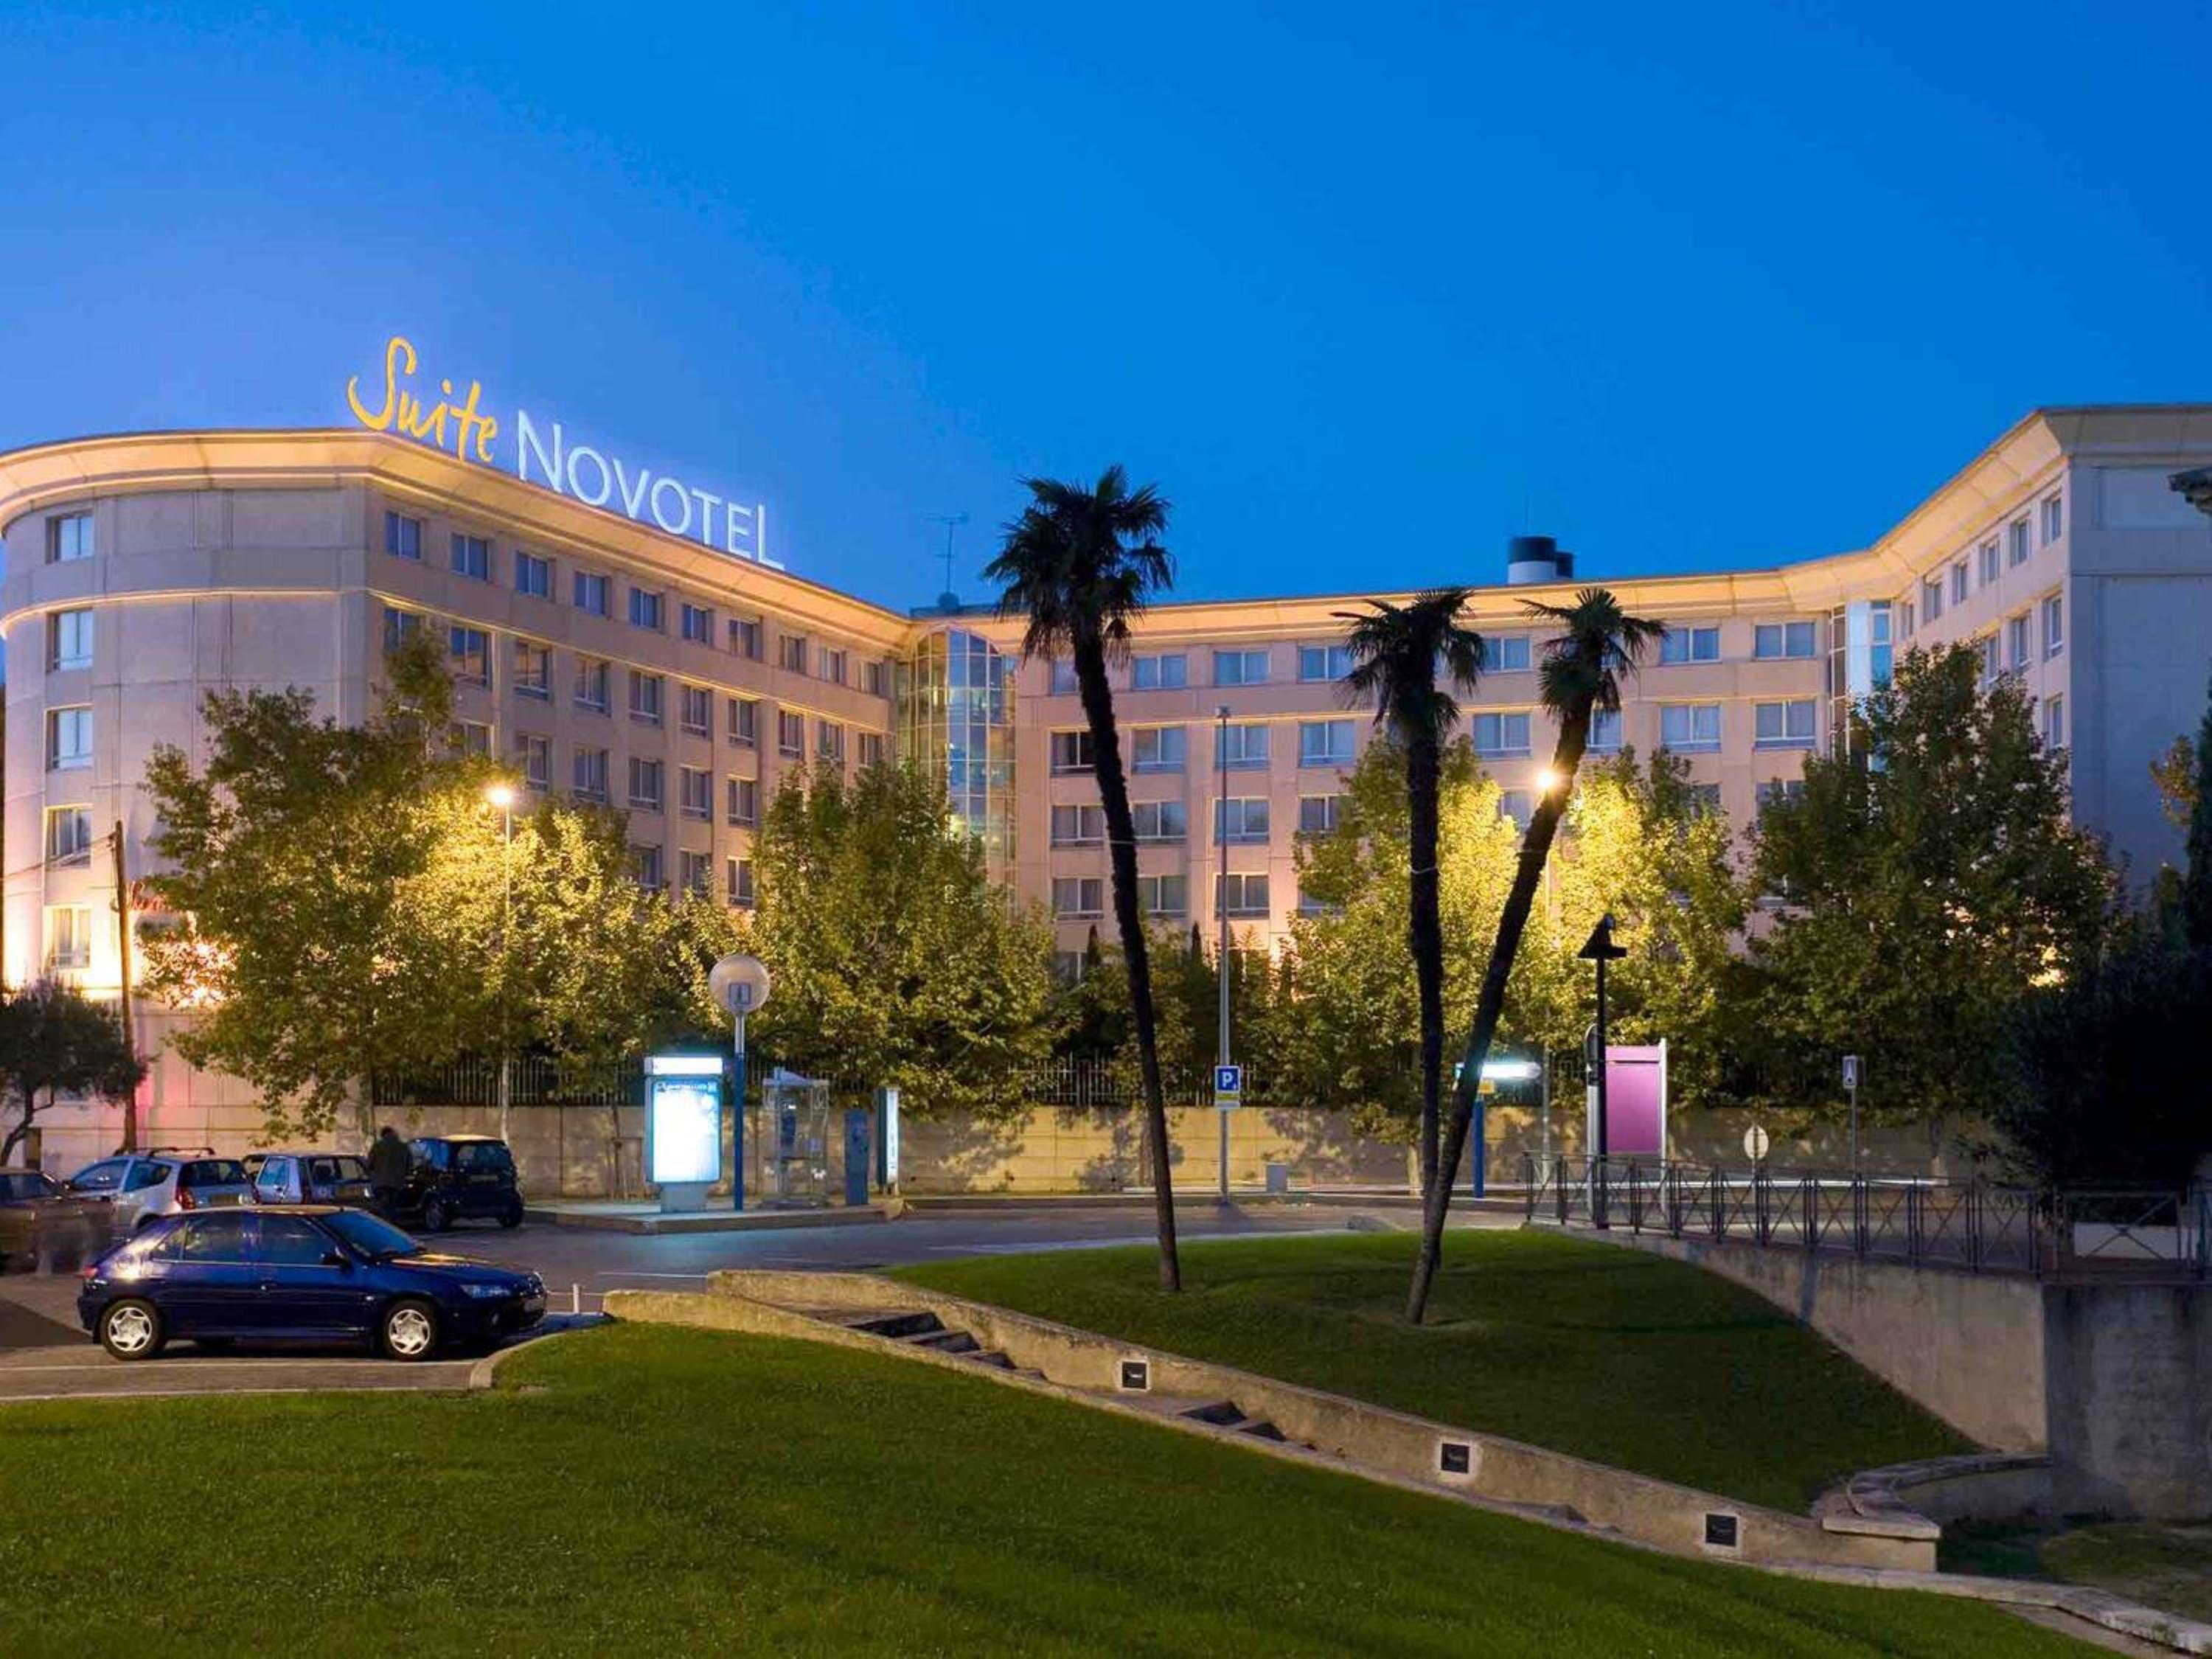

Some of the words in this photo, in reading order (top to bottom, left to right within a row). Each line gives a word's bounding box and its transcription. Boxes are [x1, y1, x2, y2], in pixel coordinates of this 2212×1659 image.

[348, 337, 498, 463] Suite
[518, 410, 785, 571] NOVOTEL
[1222, 1071, 1233, 1088] P
